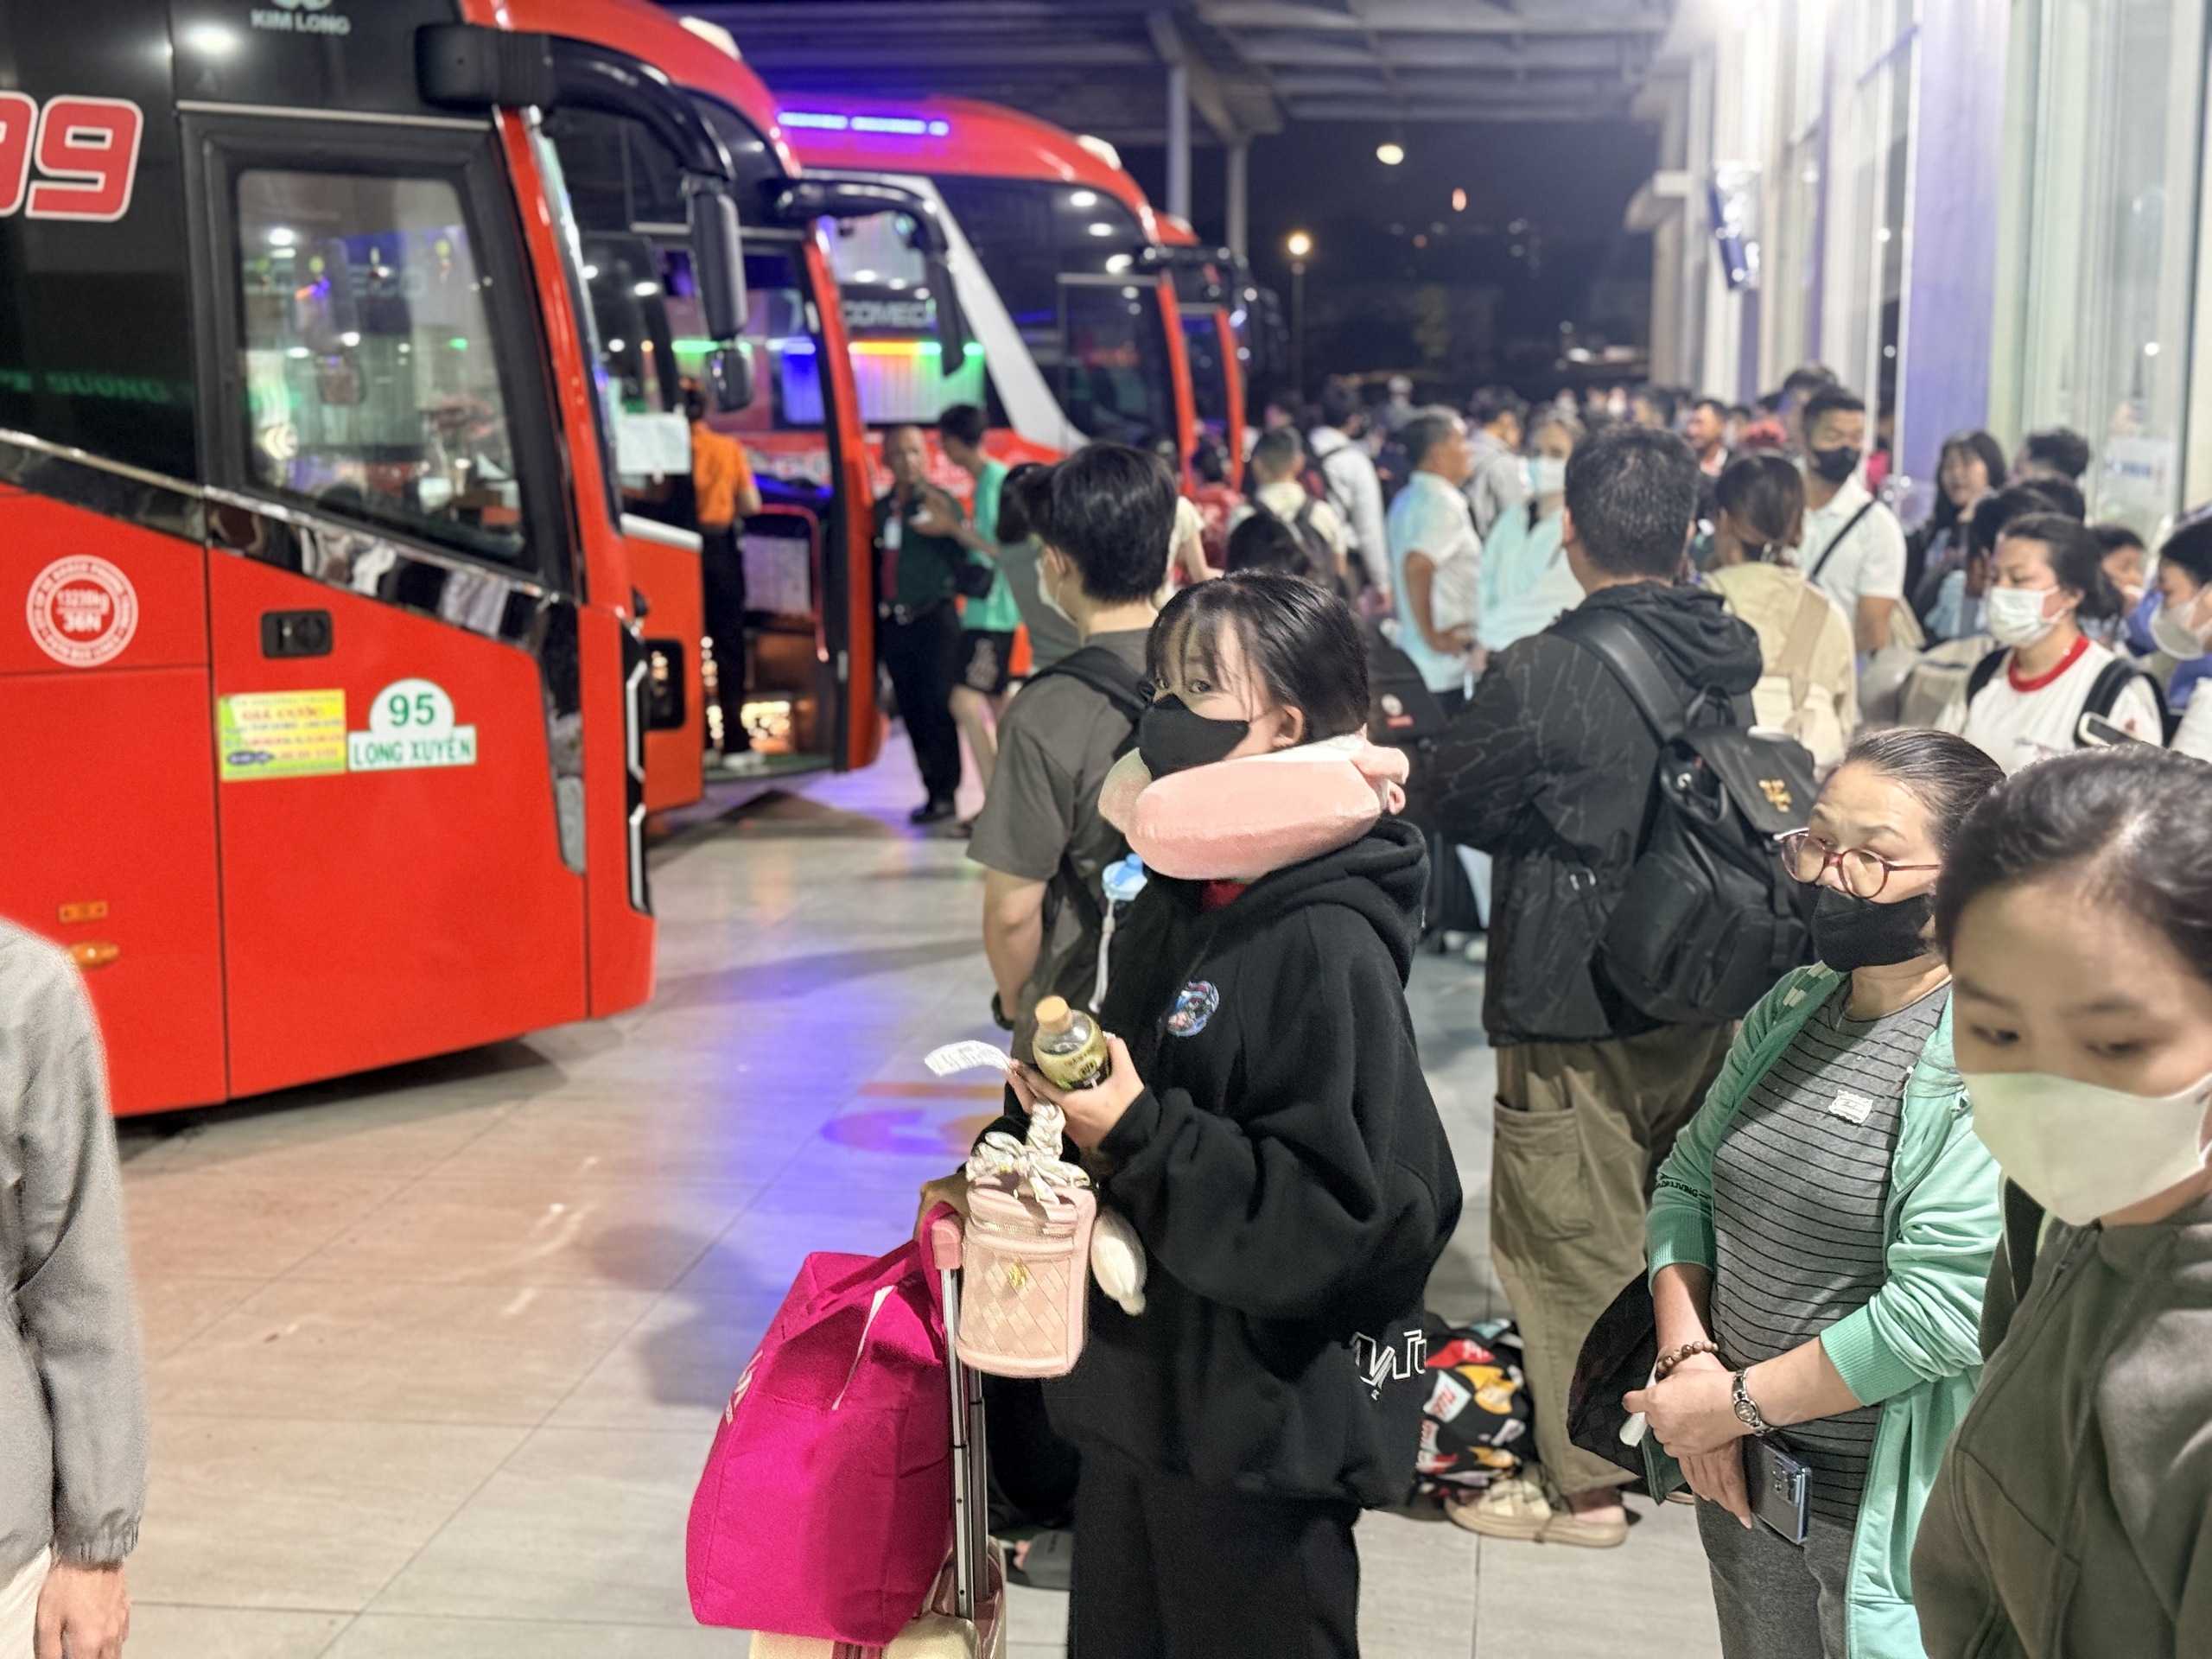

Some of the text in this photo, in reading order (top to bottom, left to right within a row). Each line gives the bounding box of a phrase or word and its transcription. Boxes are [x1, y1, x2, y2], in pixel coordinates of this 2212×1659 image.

[251, 9, 352, 35] KIM LONG
[388, 693, 436, 727] 95
[353, 742, 404, 766] LONG
